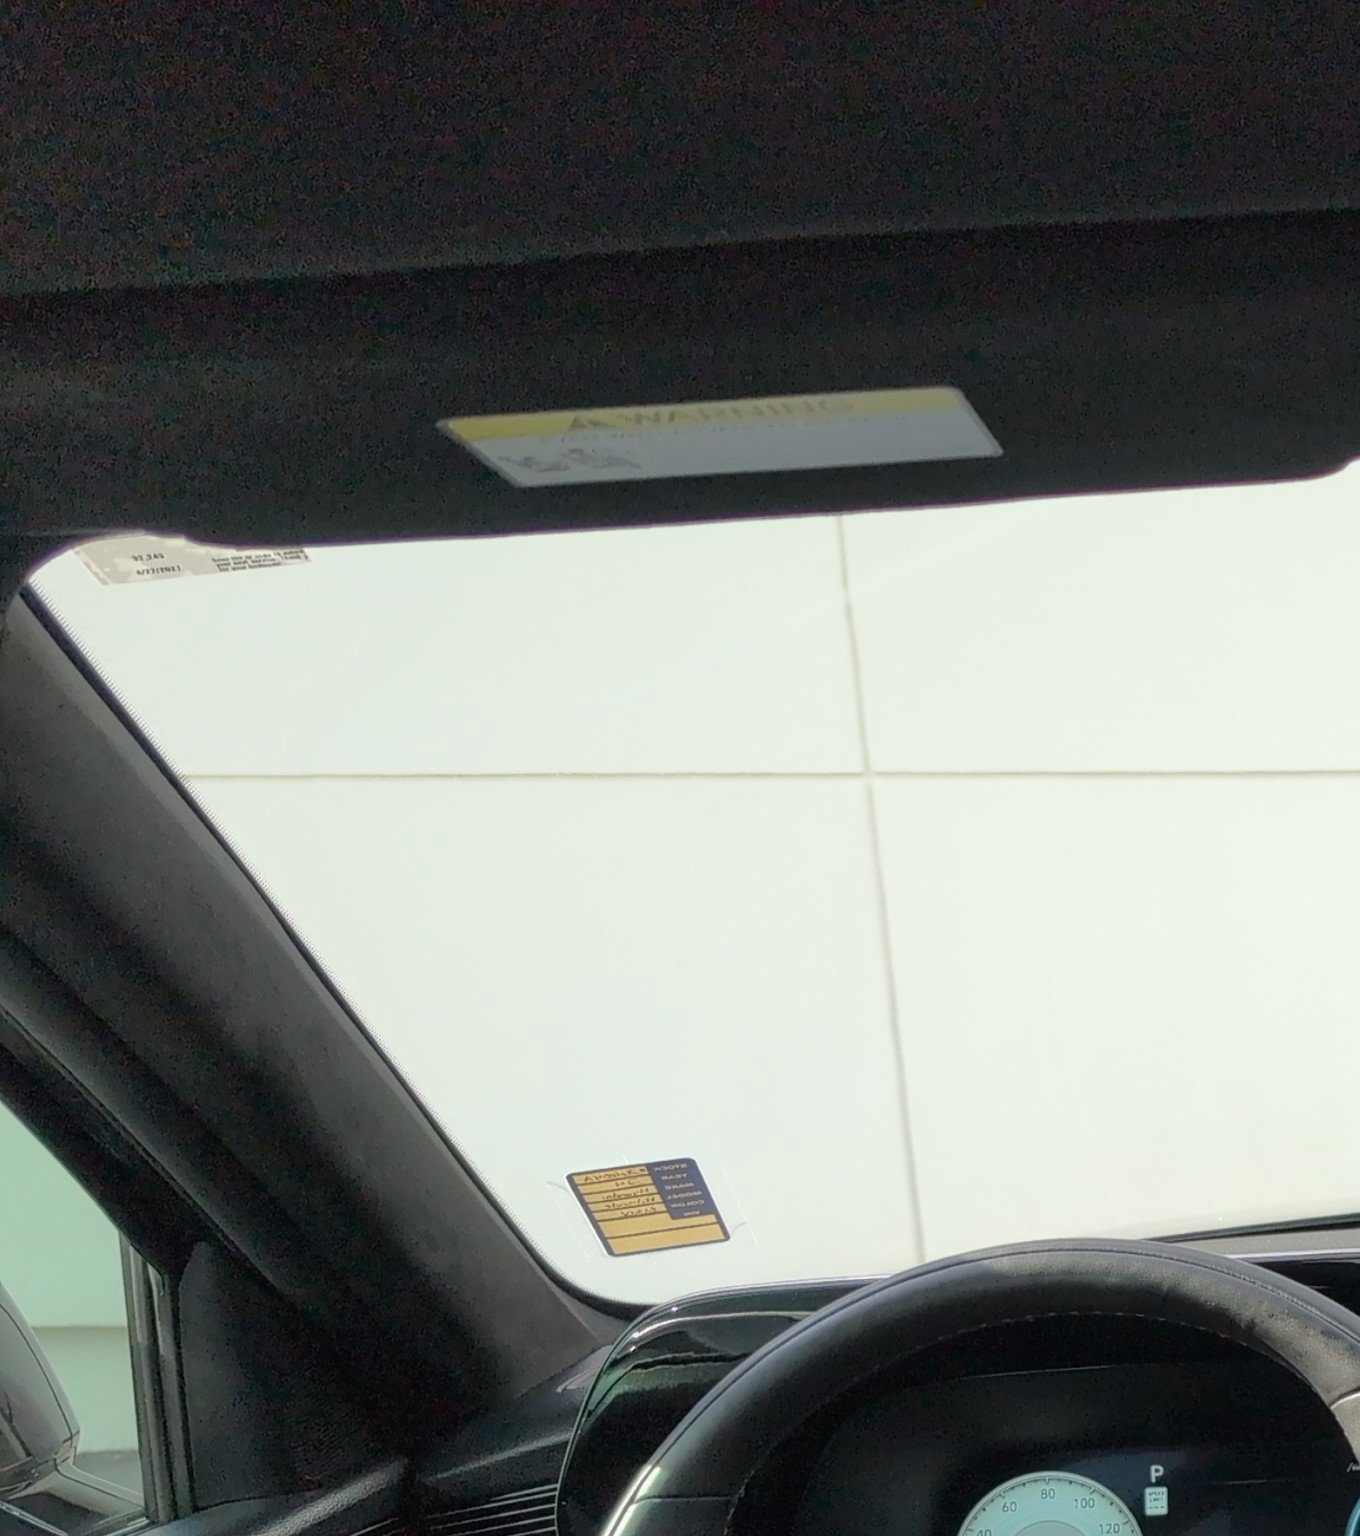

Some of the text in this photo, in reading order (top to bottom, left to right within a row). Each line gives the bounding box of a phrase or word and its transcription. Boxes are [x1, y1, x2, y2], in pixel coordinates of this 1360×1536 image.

[1150, 1464, 1164, 1484] P
[1040, 1487, 1056, 1500] 80
[1002, 1501, 1018, 1513] 60
[1074, 1498, 1096, 1509] 100
[1099, 1523, 1120, 1535] 120
